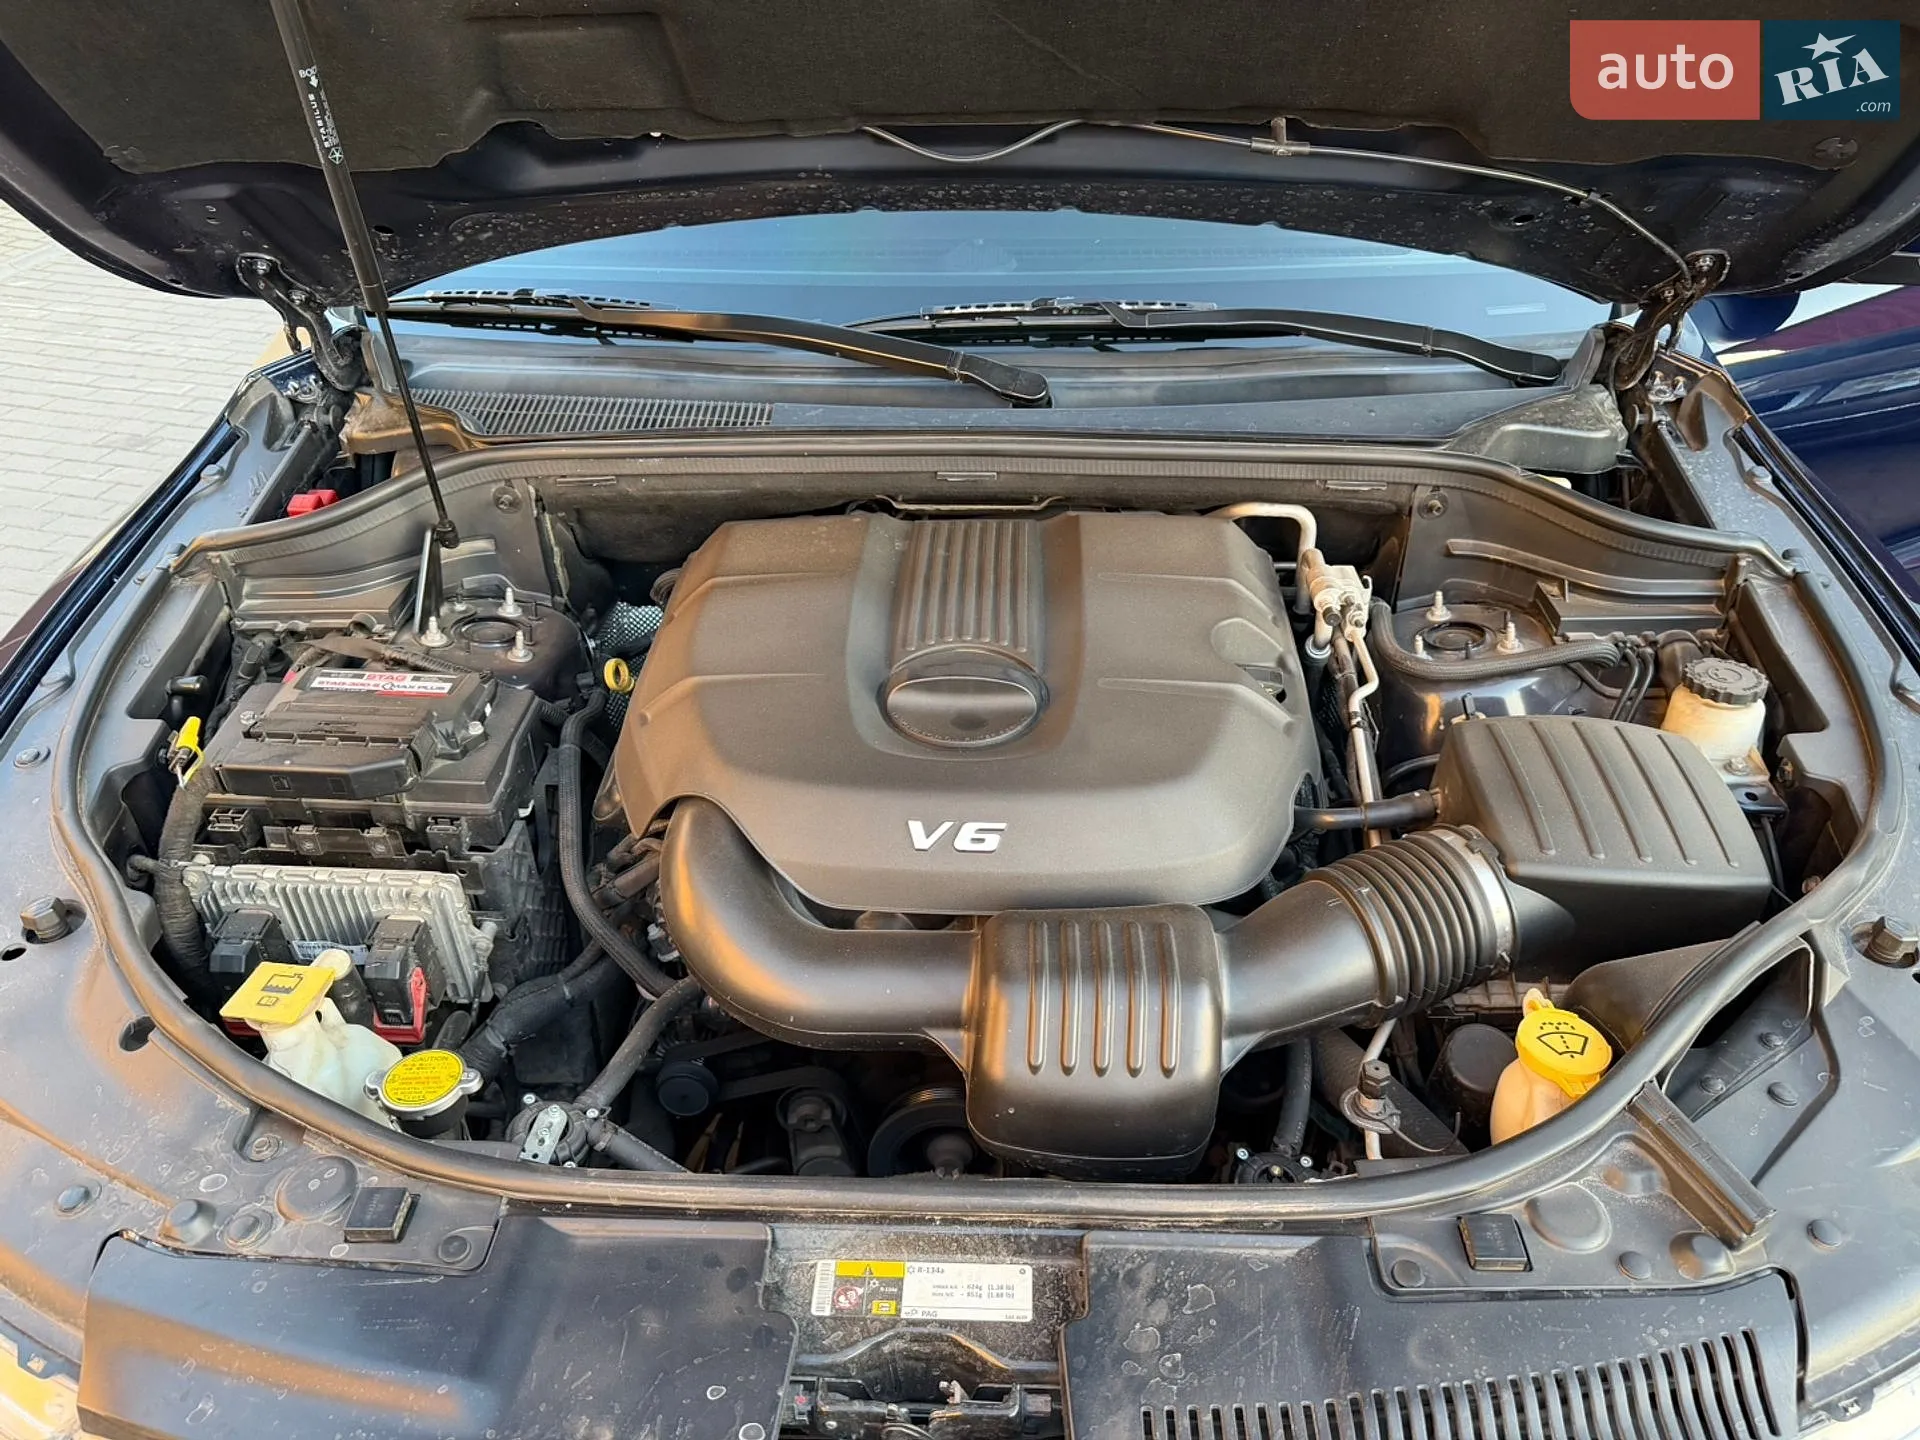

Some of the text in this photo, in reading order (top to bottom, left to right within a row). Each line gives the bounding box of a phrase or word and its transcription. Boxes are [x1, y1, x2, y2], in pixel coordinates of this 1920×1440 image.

[366, 673, 408, 682] STAG
[907, 820, 1007, 853] V6
[917, 1267, 945, 1275] R-134a
[921, 1310, 938, 1318] PAG
